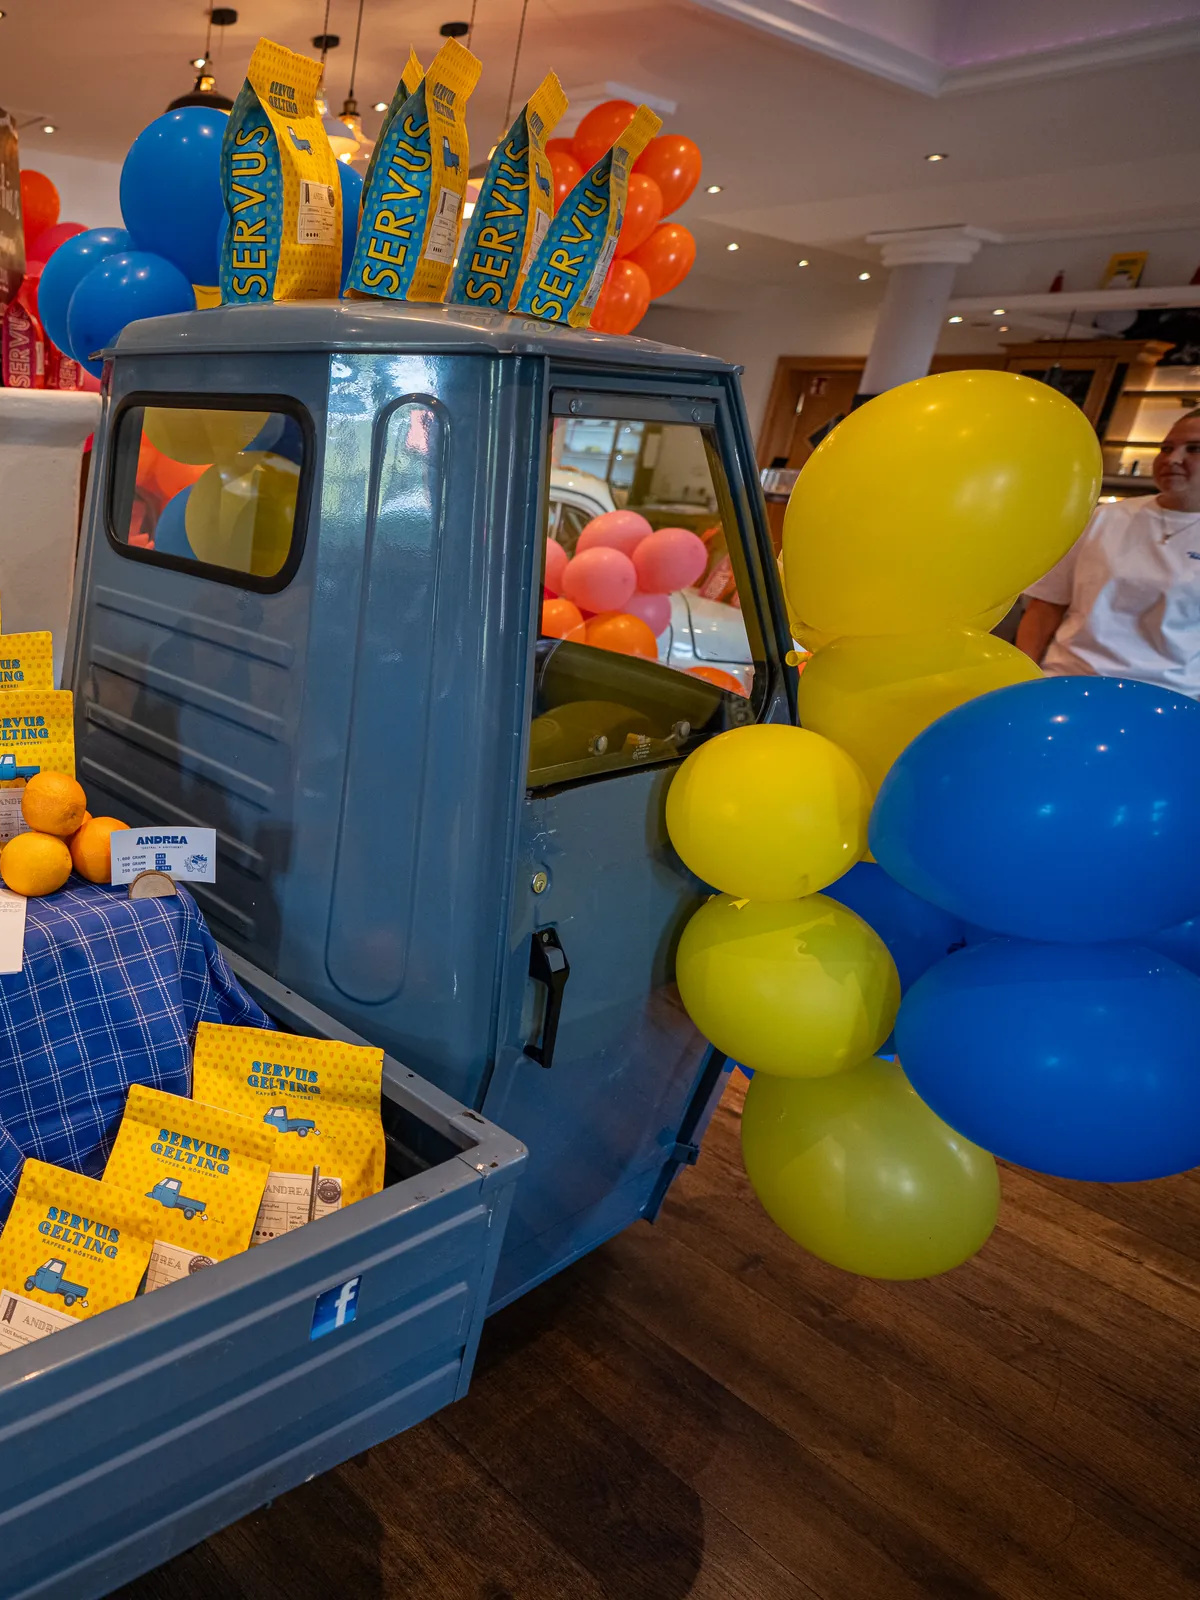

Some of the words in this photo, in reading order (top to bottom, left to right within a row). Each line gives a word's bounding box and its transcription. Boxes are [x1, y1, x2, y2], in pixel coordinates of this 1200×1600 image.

[230, 125, 270, 298] SERVUS
[362, 114, 432, 294] SERVUS
[466, 139, 530, 305] SERVUS
[530, 168, 611, 321] SERVUS
[136, 836, 188, 845] ANDREA
[247, 1074, 321, 1094] GELTING
[251, 1060, 318, 1083] SERVUS
[151, 1142, 229, 1176] GELTING
[158, 1128, 230, 1161] SERVUS
[156, 1158, 180, 1167] KAFFEE
[265, 1185, 311, 1197] ANDREA
[38, 1220, 118, 1259] GELTING
[47, 1206, 120, 1243] SERVUS
[42, 1239, 65, 1251] KAFFEE
[151, 1252, 181, 1270] DREA
[334, 1277, 357, 1326] f
